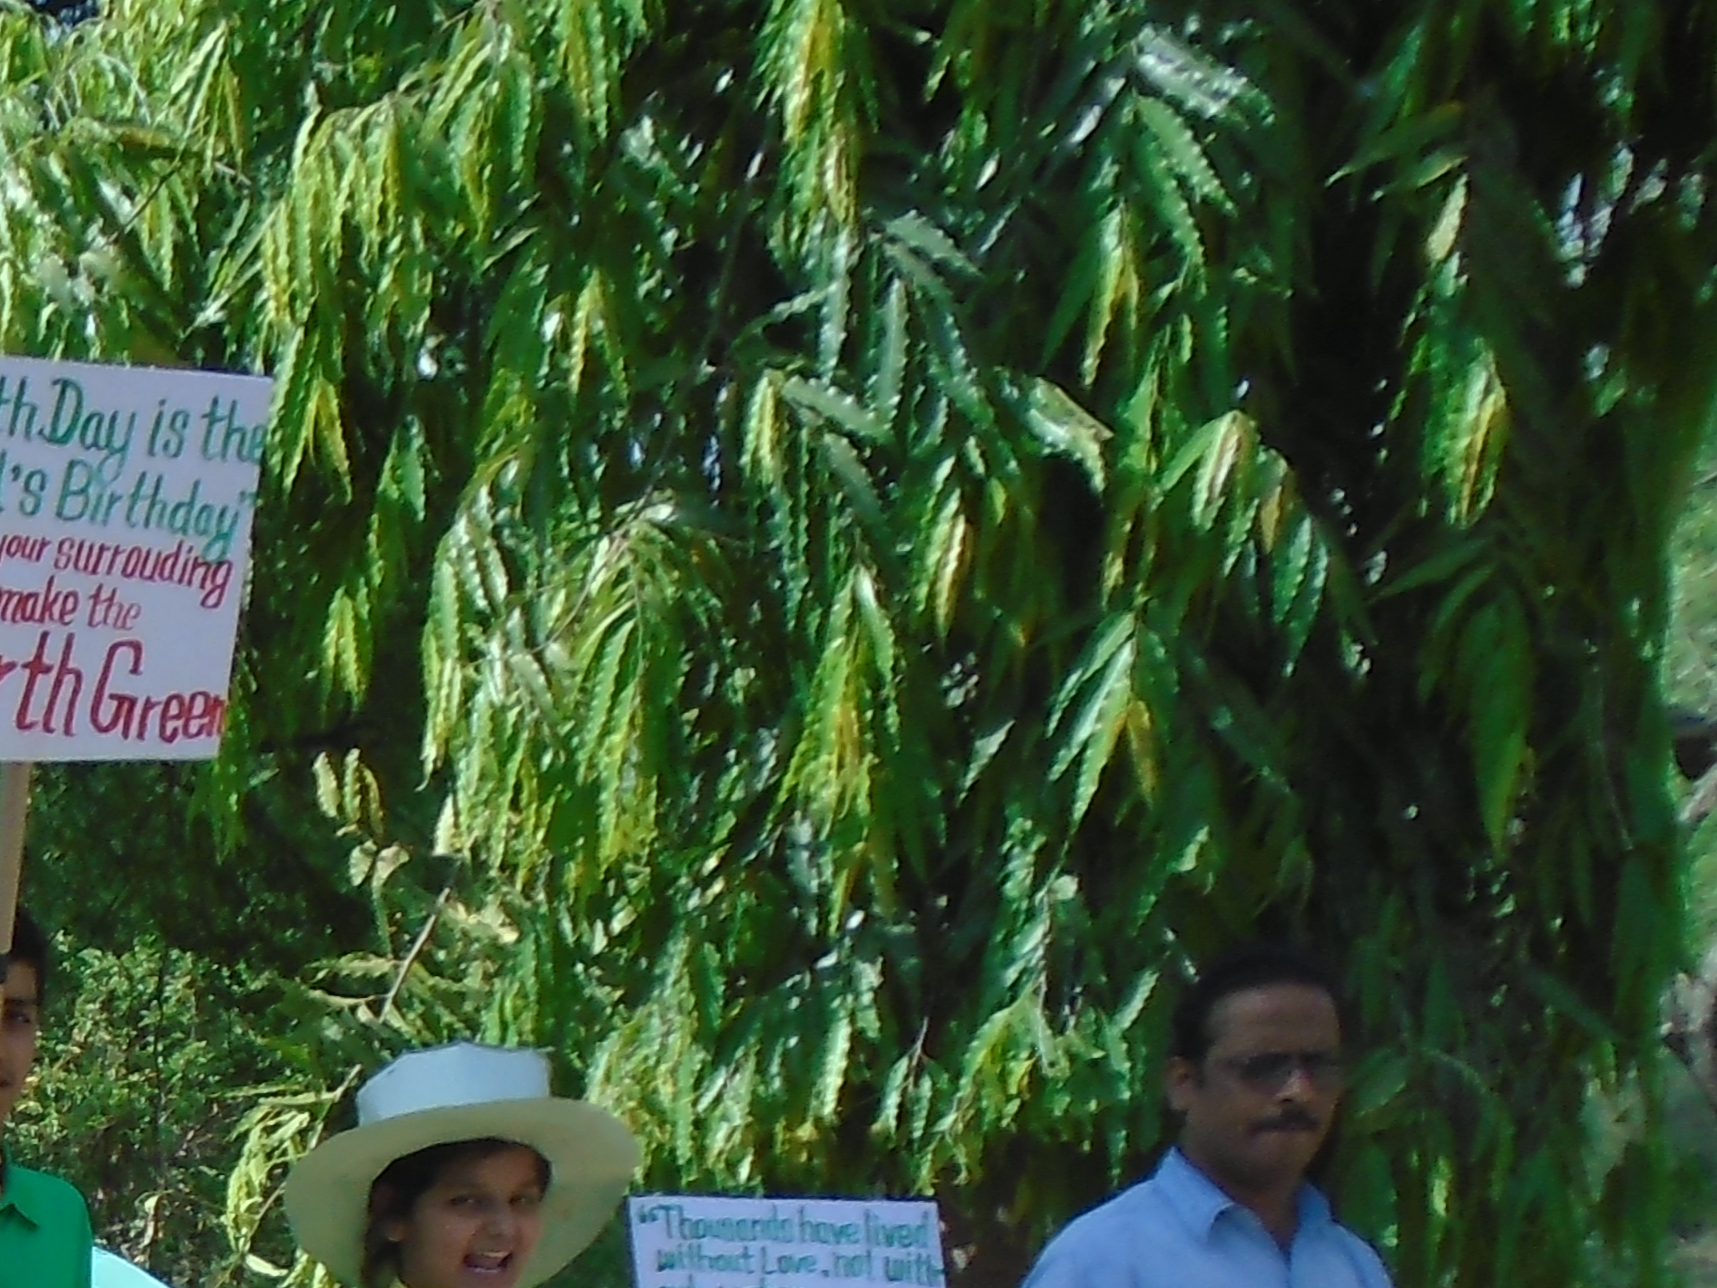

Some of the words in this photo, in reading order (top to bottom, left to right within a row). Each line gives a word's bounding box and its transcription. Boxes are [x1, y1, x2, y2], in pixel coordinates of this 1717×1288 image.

[38, 377, 137, 485] Day
[148, 399, 191, 458] is
[201, 395, 268, 463] the
[53, 535, 233, 610] surrouding
[88, 588, 142, 632] the
[89, 639, 227, 744] Green
[798, 1206, 862, 1244] have
[864, 1208, 929, 1247] lived
[656, 1243, 754, 1273] without
[833, 1250, 873, 1280] not
